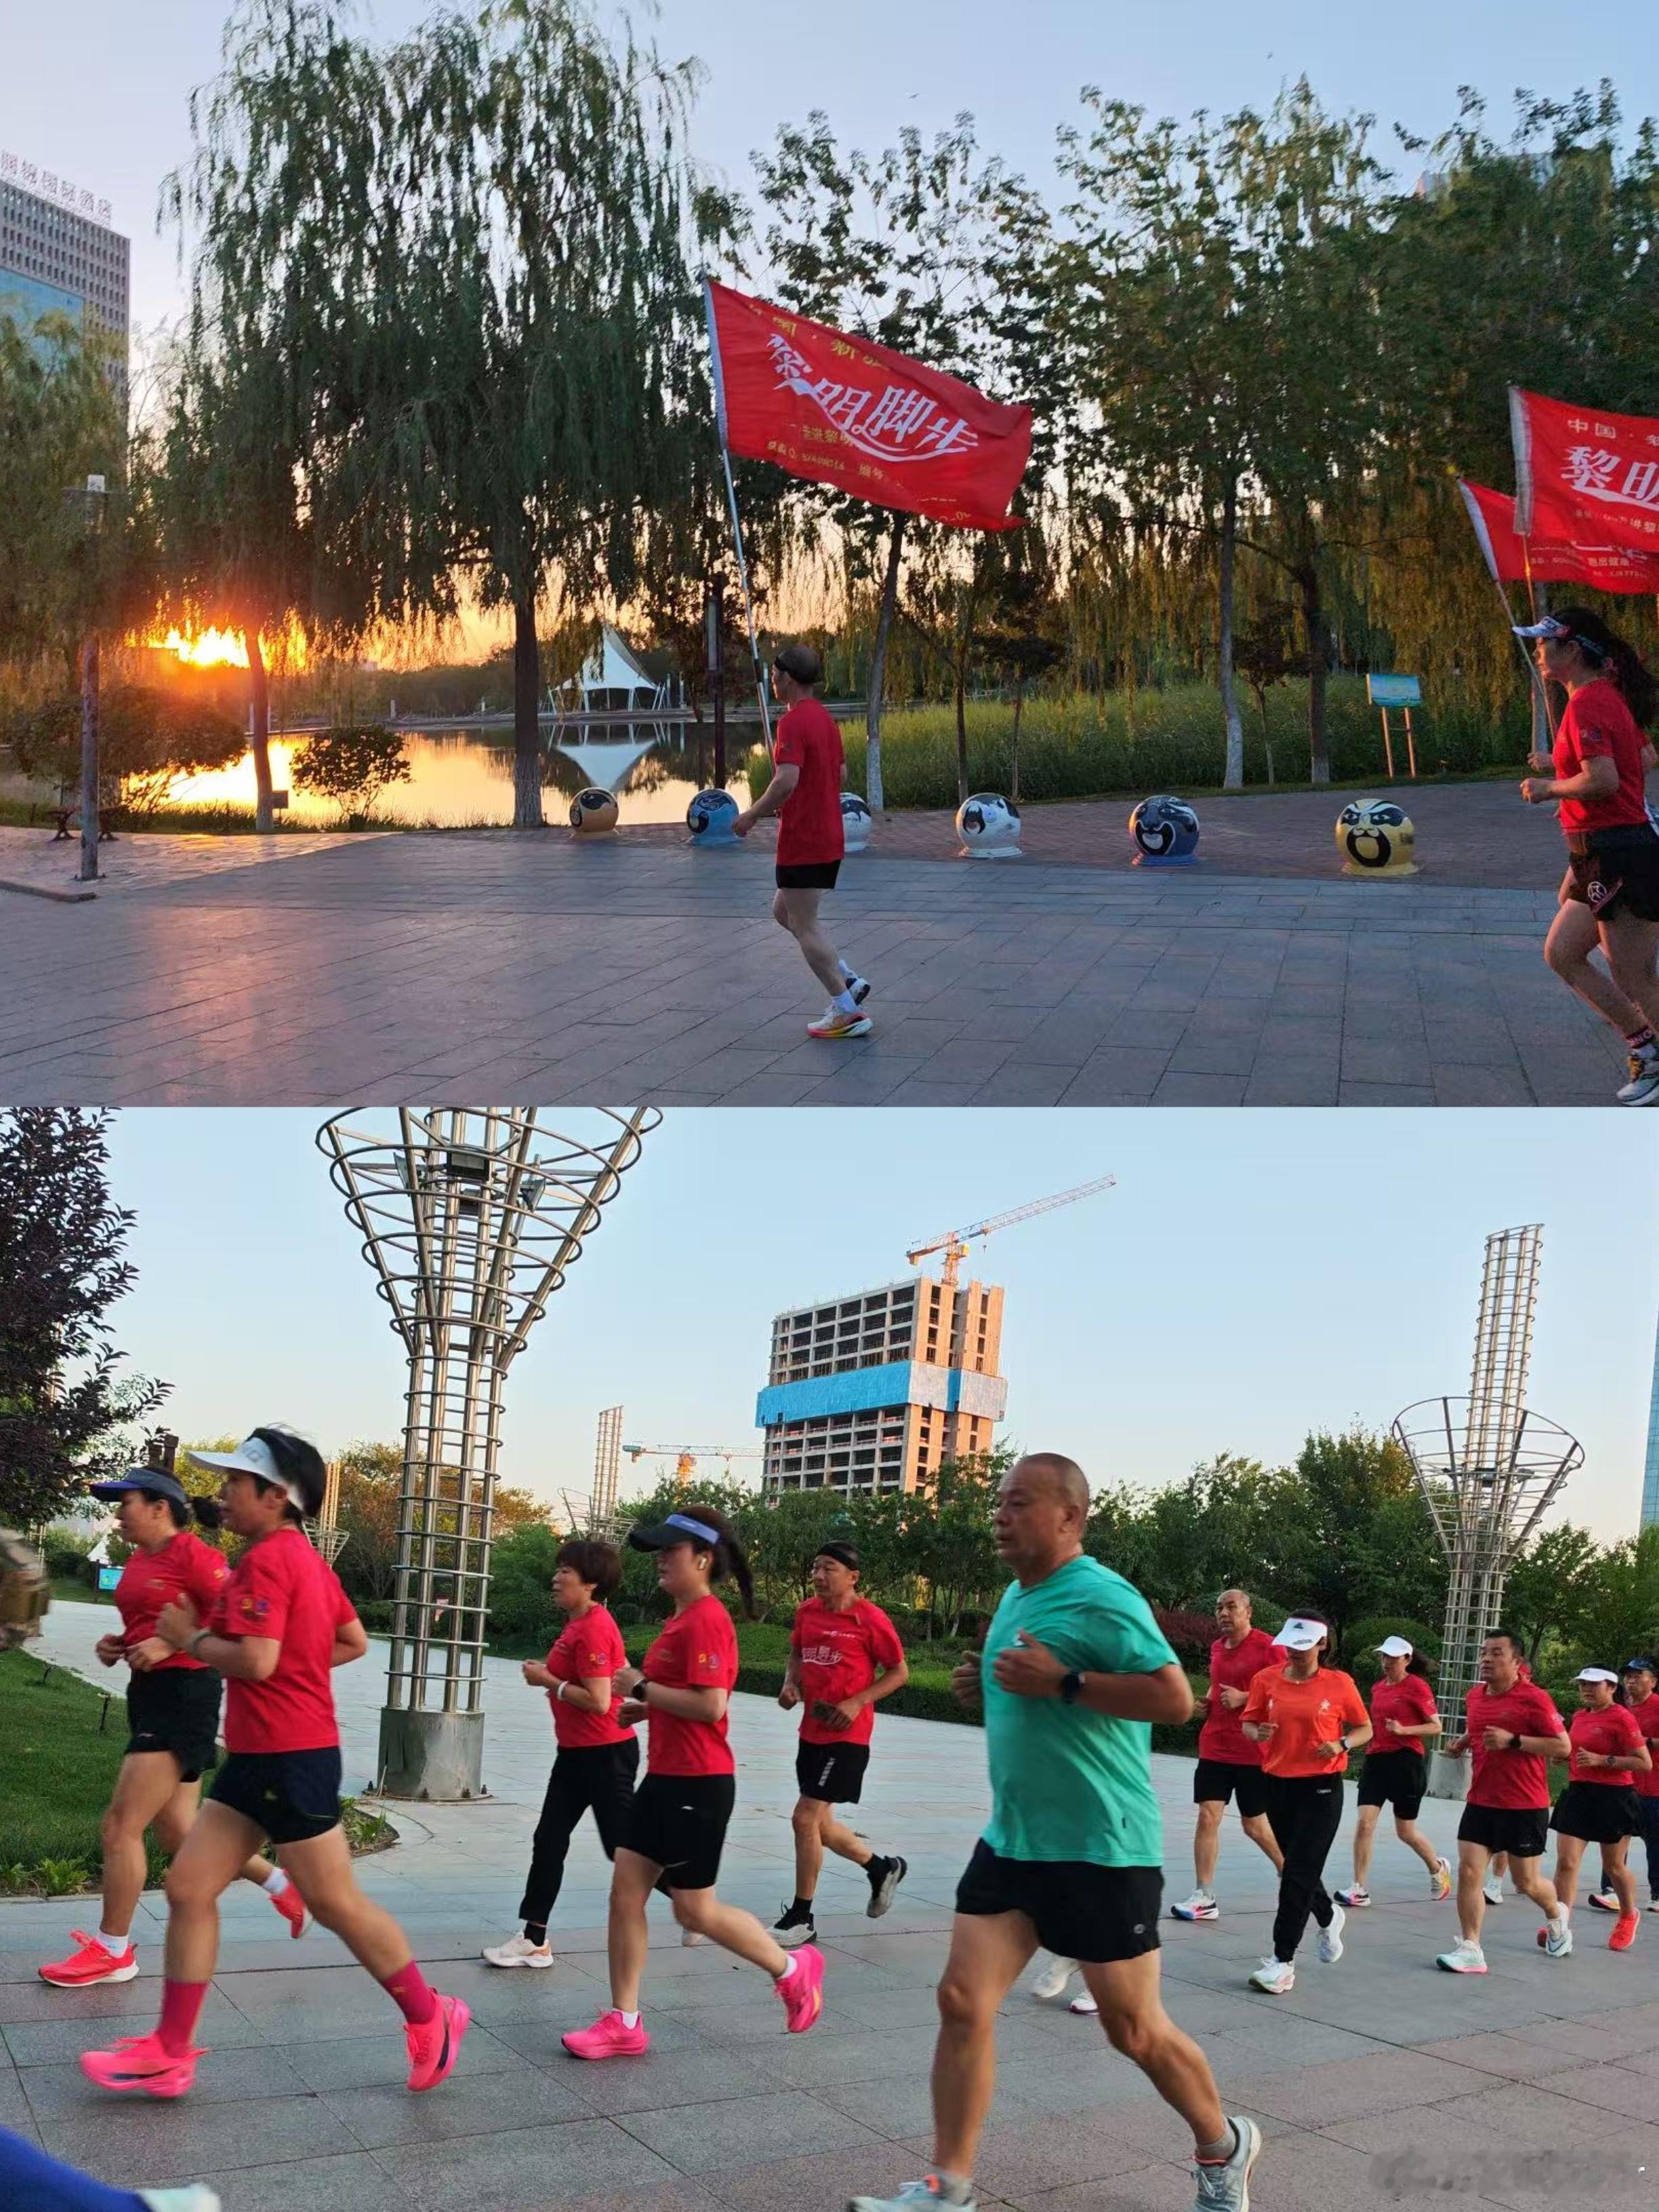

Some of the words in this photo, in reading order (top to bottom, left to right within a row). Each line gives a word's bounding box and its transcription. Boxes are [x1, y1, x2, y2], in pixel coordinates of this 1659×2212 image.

[766, 333, 979, 449] 黎明脚步
[1568, 418, 1616, 439] 中国
